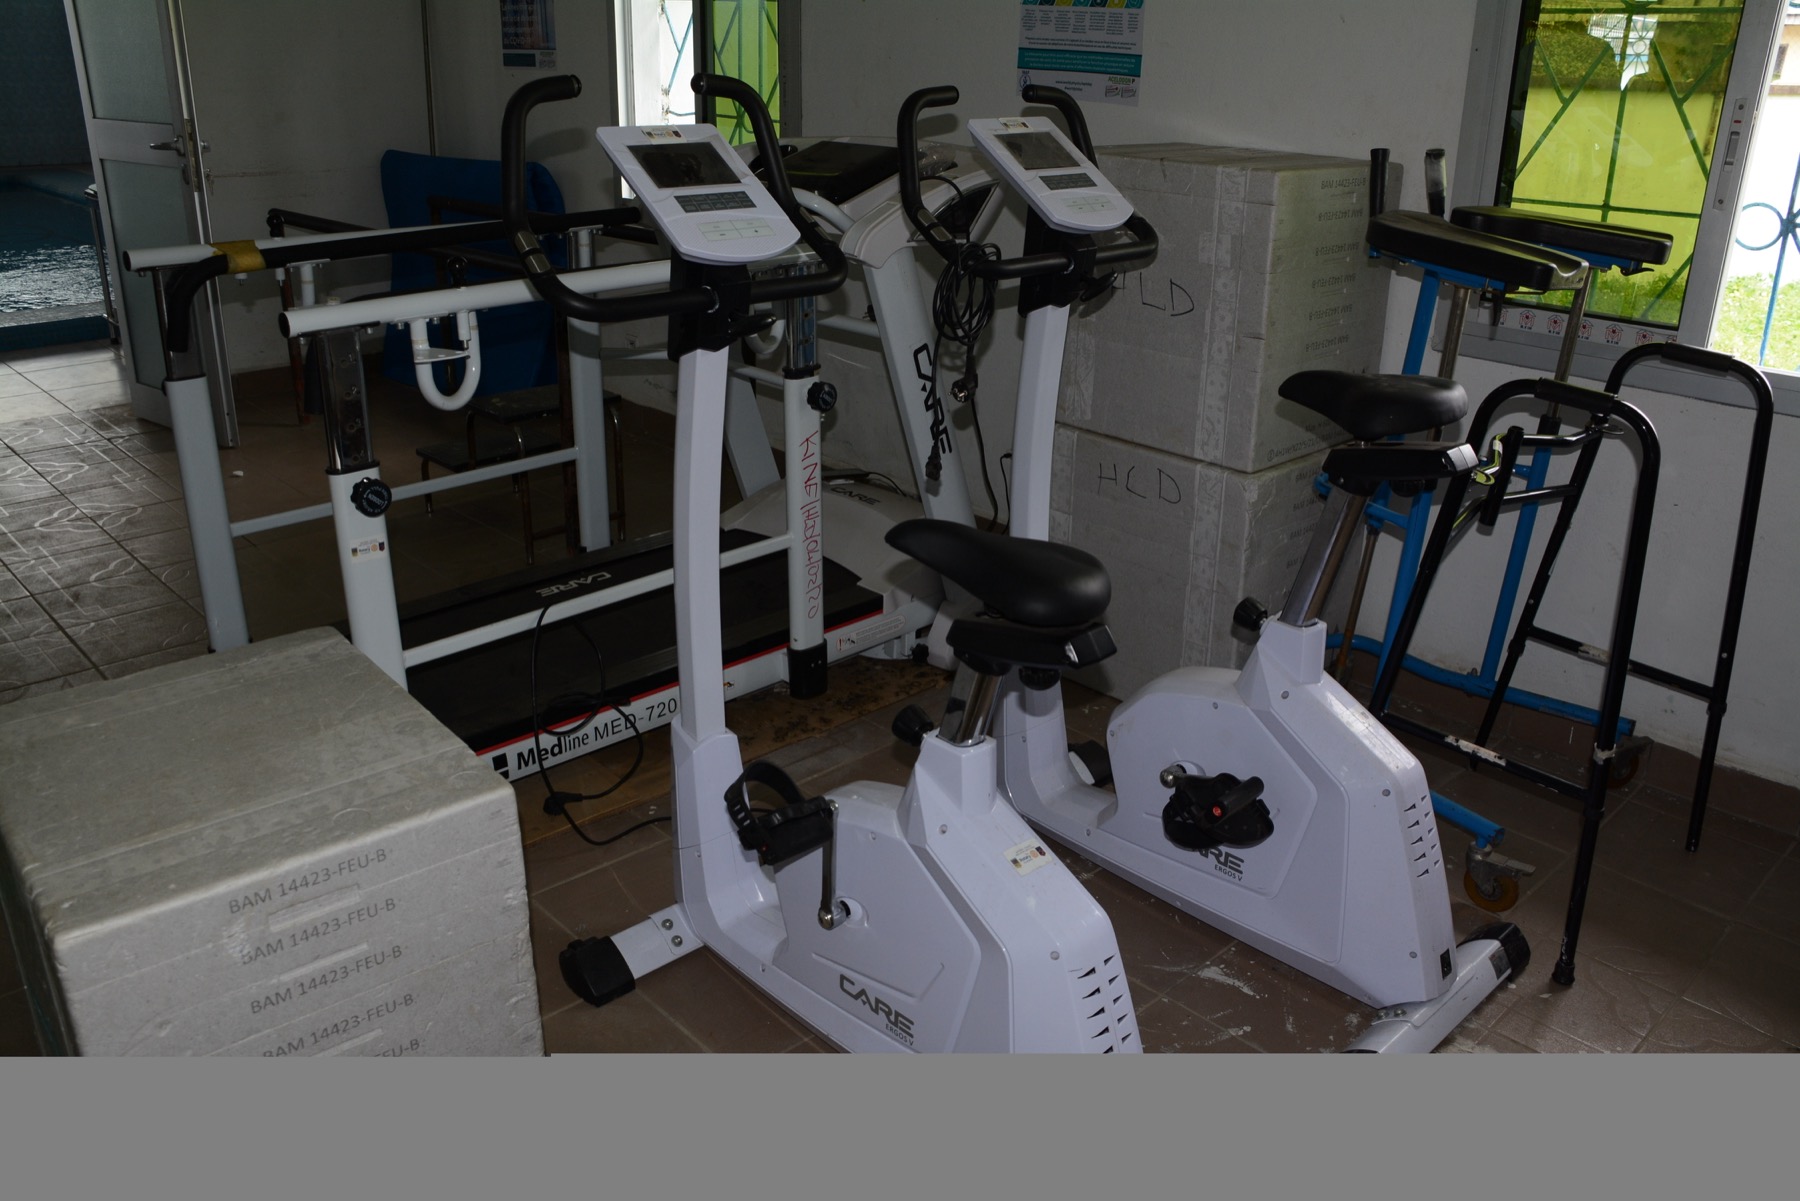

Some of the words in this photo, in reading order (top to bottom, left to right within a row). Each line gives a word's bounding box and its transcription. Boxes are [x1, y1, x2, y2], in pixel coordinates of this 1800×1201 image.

[830, 487, 880, 505] CARE
[536, 571, 612, 597] CARE
[517, 731, 589, 770] Medline
[593, 698, 677, 741] MED-720
[228, 888, 272, 914] BAM
[277, 848, 387, 898] 14423-FEU-B
[1214, 864, 1237, 879] ERGOS
[289, 898, 396, 948] 14423-FEU-B
[251, 988, 292, 1014] BAM
[298, 945, 403, 996] 14423-FEU-B
[310, 993, 414, 1046] 14423-FEU-B
[840, 974, 914, 1039] CARE
[886, 1023, 908, 1042] ERGOS
